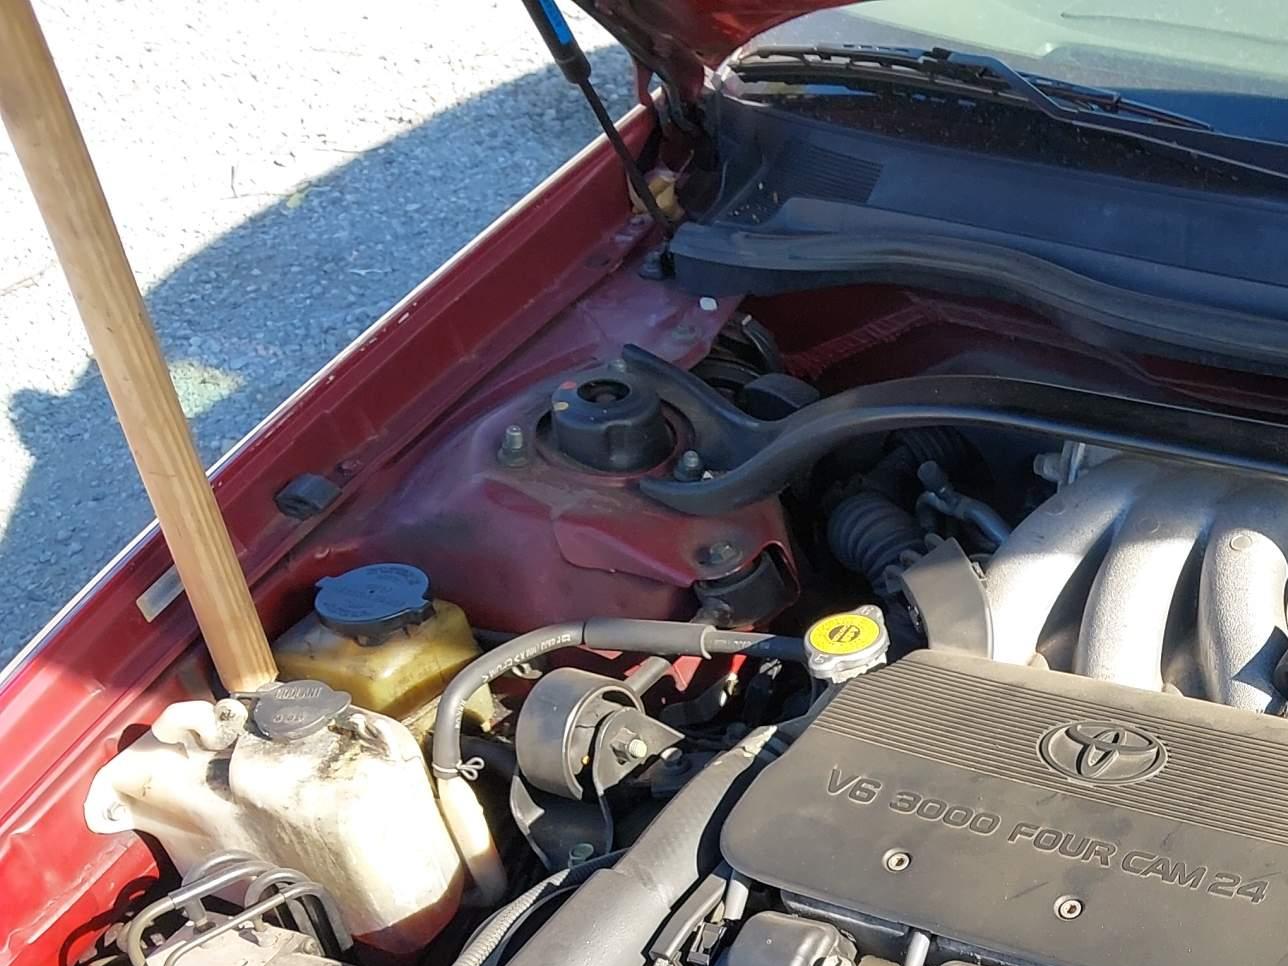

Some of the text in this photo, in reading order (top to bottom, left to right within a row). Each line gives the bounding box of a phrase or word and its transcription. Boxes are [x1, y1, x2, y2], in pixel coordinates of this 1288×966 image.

[827, 766, 1270, 905] V6 3000 FOUR CAM 24
